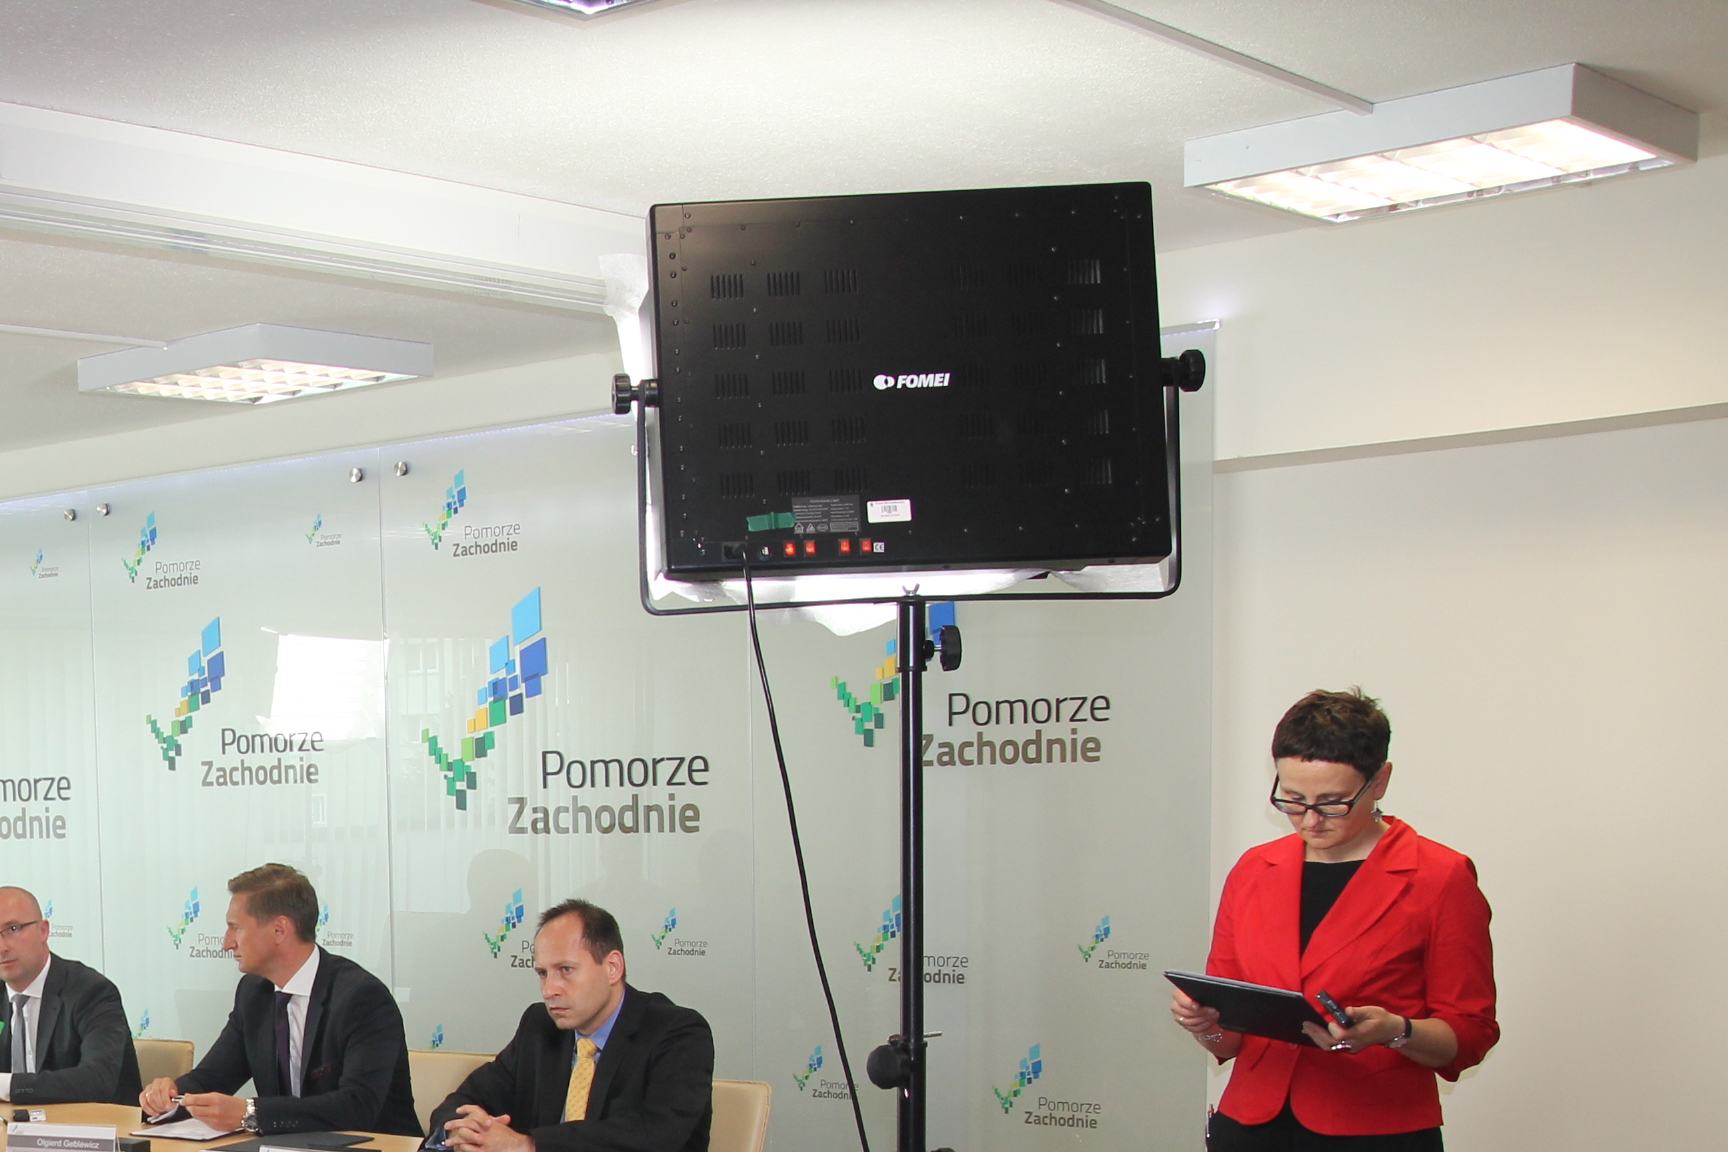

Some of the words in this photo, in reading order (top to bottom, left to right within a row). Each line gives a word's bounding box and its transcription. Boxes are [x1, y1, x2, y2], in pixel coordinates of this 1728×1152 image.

[896, 372, 951, 389] FOMEI
[464, 522, 521, 541] Pomorze
[452, 538, 518, 557] Zachodnie
[155, 558, 201, 574] Pomorze
[146, 573, 199, 590] Zachodnie
[947, 691, 1111, 727] Pomorze
[220, 726, 324, 756] Pomorze
[200, 757, 319, 787] Zachodnie
[541, 749, 710, 790] Pomorze
[507, 793, 701, 835] Zachodnie
[667, 947, 706, 956] Zachodnie
[674, 939, 708, 948] Pomorze
[923, 955, 969, 968] morze
[1107, 950, 1150, 960] Pomorze
[1098, 960, 1147, 970] Zachodnie
[1038, 1097, 1102, 1114] Pomorze
[1024, 1111, 1098, 1129] Zachodnie
[36, 1138, 62, 1148] Olgierd
[63, 1139, 100, 1150] Geblewicz
